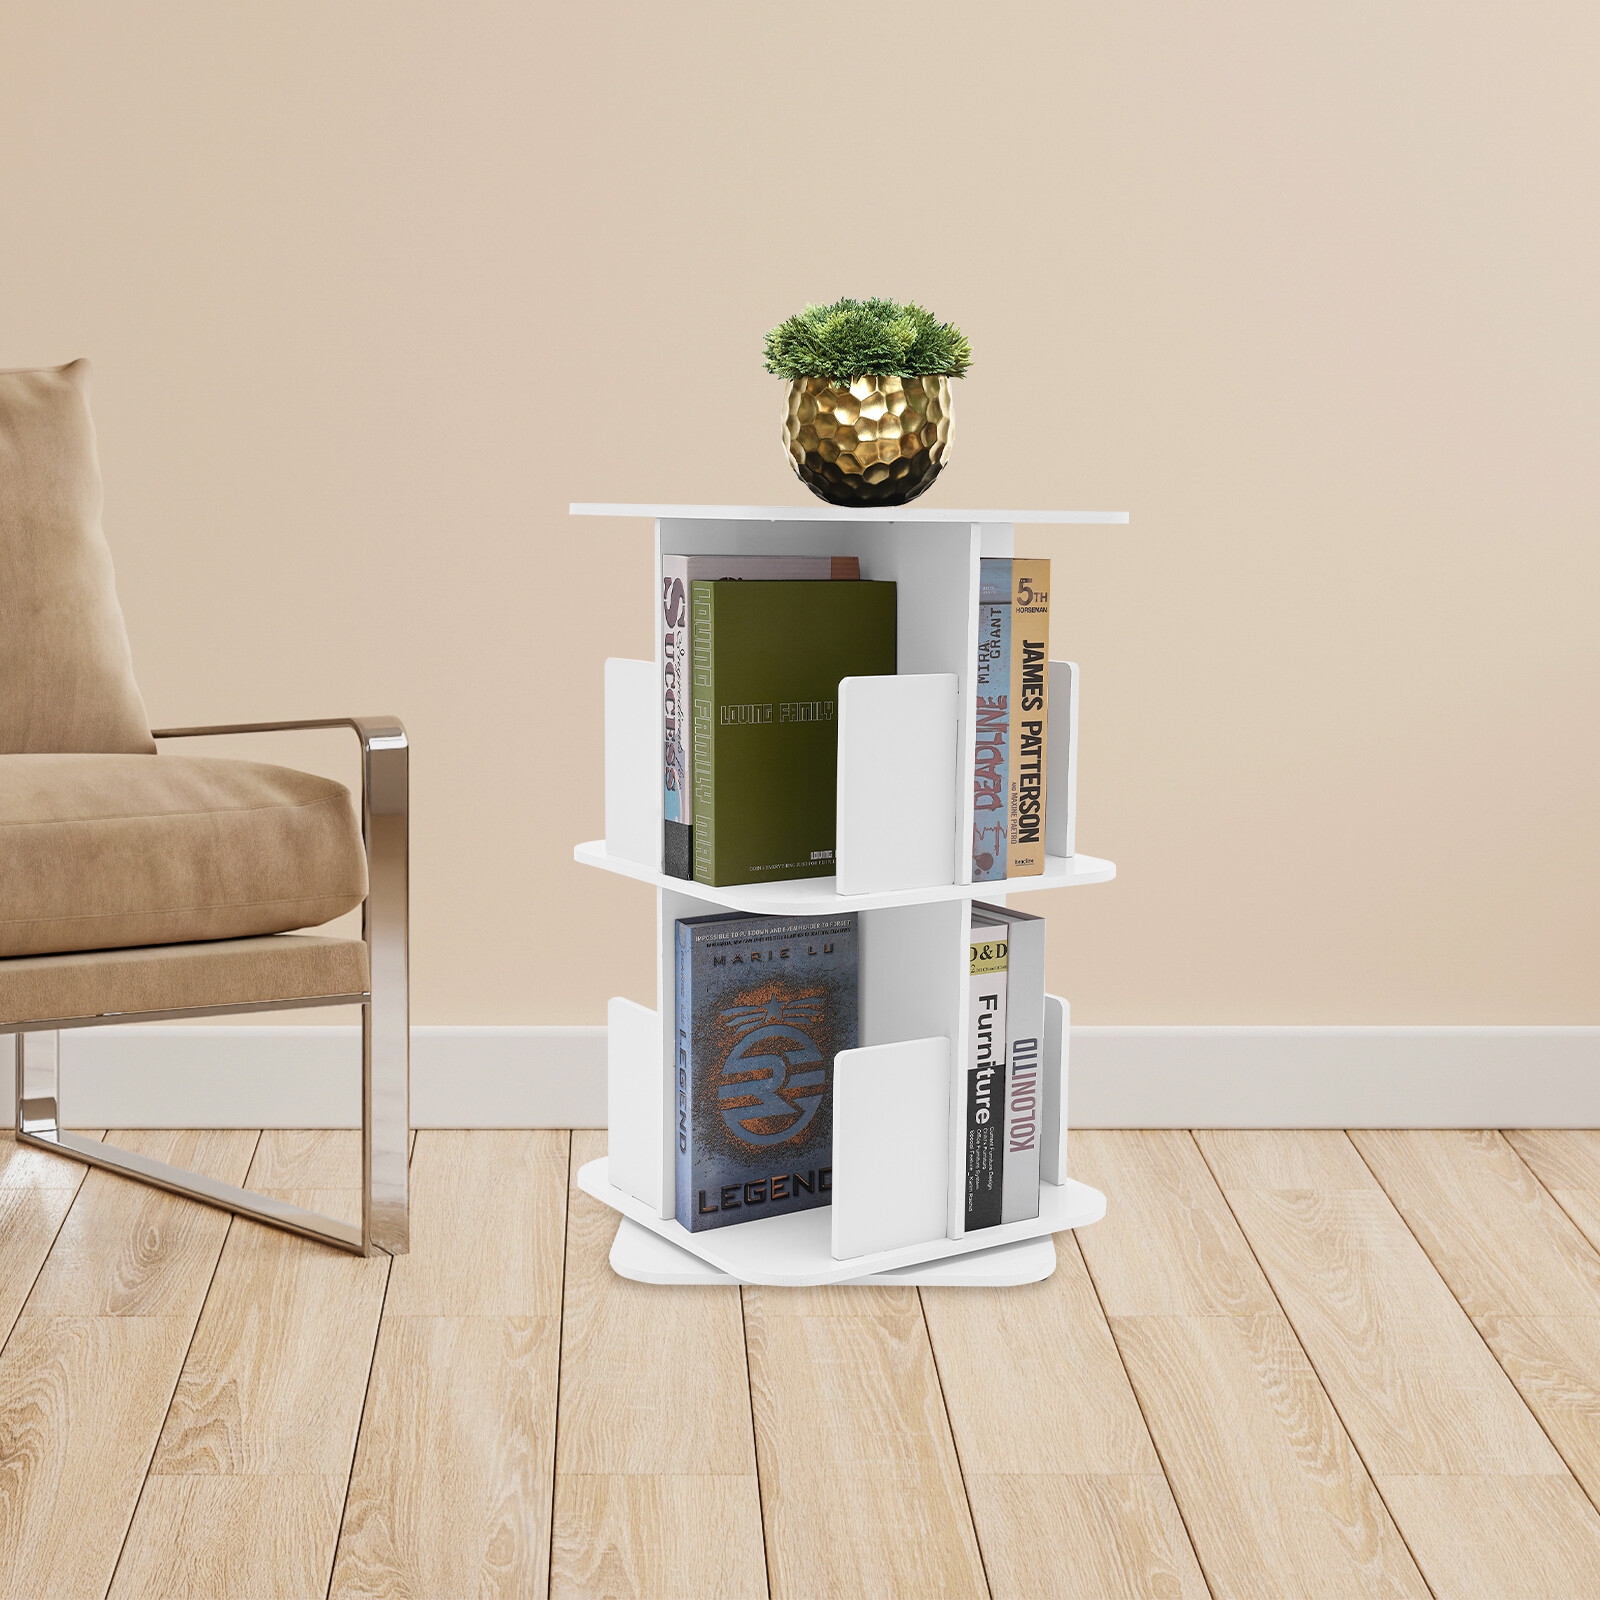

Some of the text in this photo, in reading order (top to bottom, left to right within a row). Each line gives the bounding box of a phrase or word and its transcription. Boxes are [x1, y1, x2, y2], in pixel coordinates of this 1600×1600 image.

[664, 577, 686, 792] SUCCESS
[978, 641, 990, 684] MIRA
[989, 607, 1002, 659] GRANT
[694, 588, 712, 879] LOVING FAMILY MAN
[720, 701, 834, 725] LOVING FAMILY
[974, 695, 1009, 811] DEADLINE
[1018, 640, 1045, 843] JAMES PATTERSON
[1010, 819, 1018, 844] PAETRO
[695, 933, 729, 942] IMPOSSIBLE
[751, 929, 769, 937] DOWN
[782, 925, 798, 933] EVEN
[799, 922, 821, 931] HARDER
[829, 919, 851, 928] FORGET
[713, 943, 835, 967] MARIE LU
[979, 944, 994, 961] &
[995, 943, 1008, 959] D
[679, 1028, 687, 1153] LEGEND
[975, 994, 998, 1125] Furniture
[1009, 1038, 1038, 1152] KOLONITID
